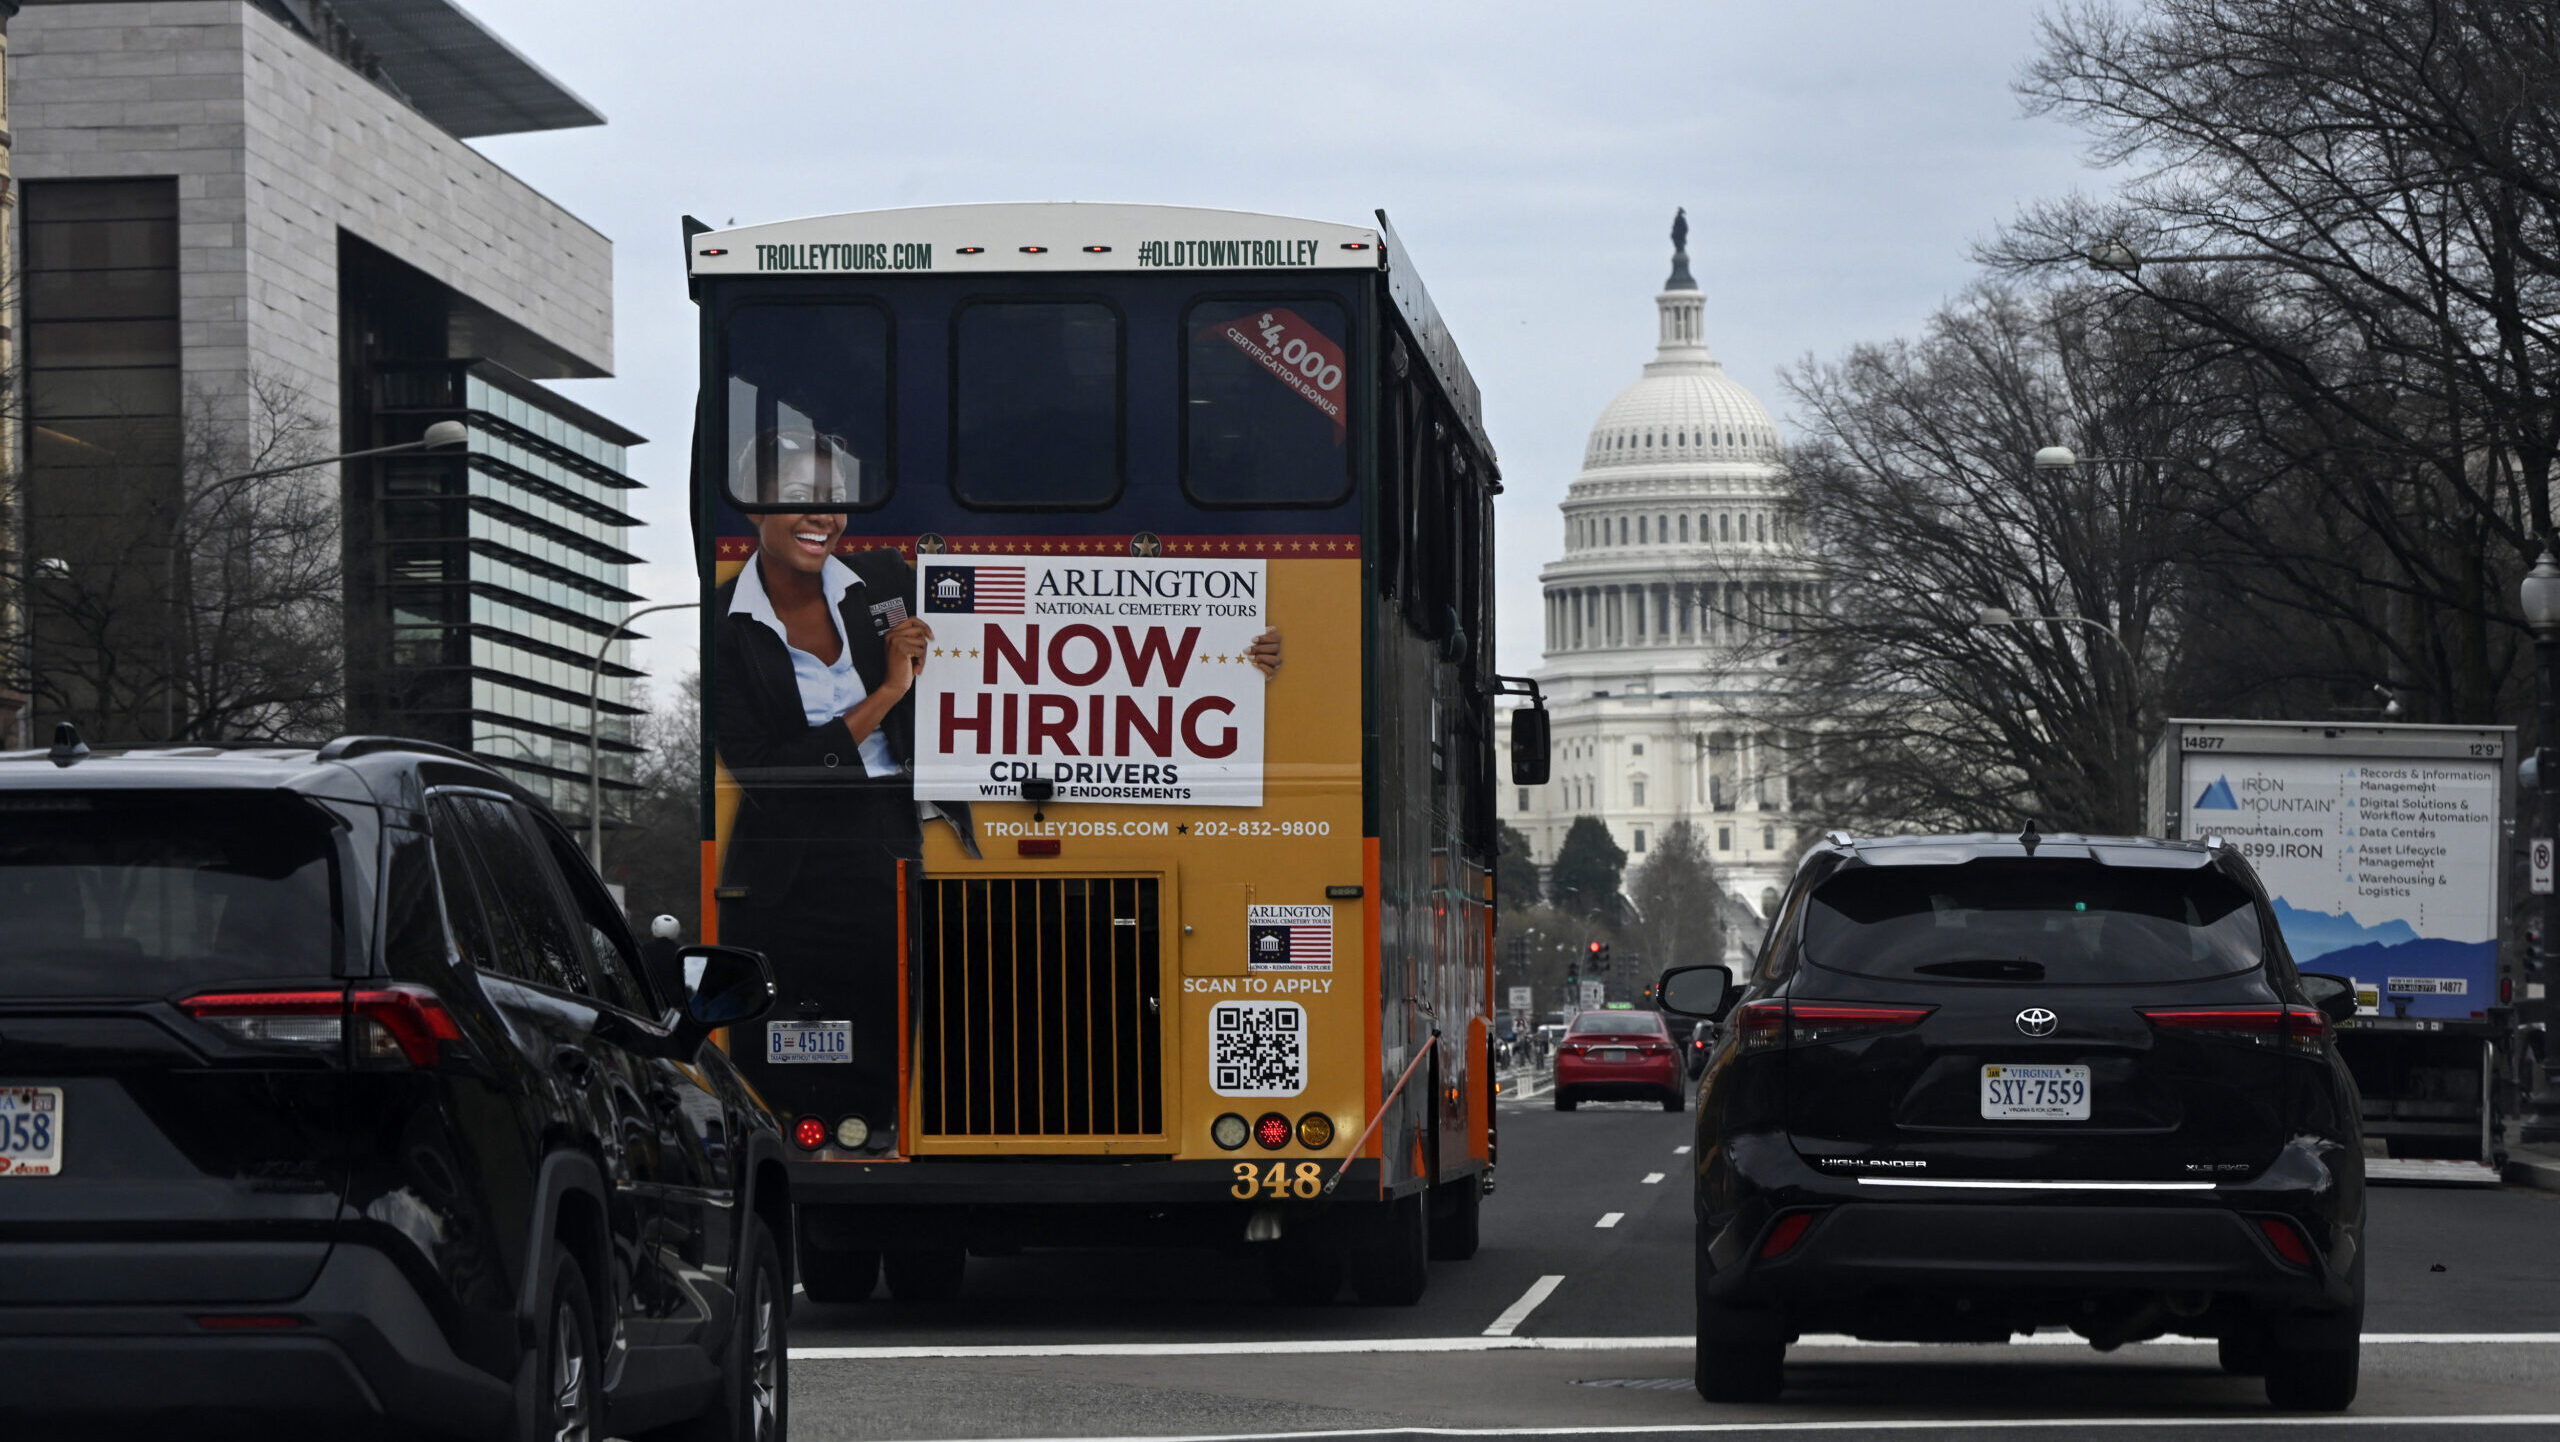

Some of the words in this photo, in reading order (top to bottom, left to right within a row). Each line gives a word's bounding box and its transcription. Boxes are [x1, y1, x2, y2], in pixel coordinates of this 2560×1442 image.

[756, 243, 932, 271] TROLLEYTOURS.COM
[1138, 240, 1318, 267] #OLDTOWNTROLLEY
[1258, 313, 1342, 391] $4,000
[1227, 327, 1301, 388] CERTIFICATION
[1301, 384, 1338, 416] BONUS
[1035, 569, 1258, 598] ARLINGTON
[1036, 602, 1114, 615] NATIONAL
[1119, 603, 1202, 616] CEMETERY
[1206, 604, 1257, 617] TOURS
[983, 623, 1201, 688] NOW
[939, 692, 1238, 759] HIRING
[2183, 736, 2224, 749] 14877
[990, 761, 1039, 782] CDL
[1054, 763, 1178, 785] DRIVERS
[2361, 768, 2407, 779] Records
[2411, 769, 2419, 779] &
[2423, 769, 2491, 780] Information
[980, 785, 1017, 796] WITH
[1070, 787, 1191, 799] ENDORSEMENTS
[2242, 778, 2284, 792] IRON
[2361, 781, 2436, 793] Management
[2360, 797, 2399, 809] Digital
[2402, 798, 2457, 809] Solutions
[2460, 800, 2469, 810] &
[2360, 811, 2415, 821] Workflow
[2420, 812, 2489, 823] Automation
[984, 821, 1169, 836] TROLLEYJOBS.COM
[1194, 821, 1330, 836] 202-832-9800
[2196, 824, 2323, 837] ironmountain.com
[2360, 827, 2388, 837] Data
[2392, 828, 2436, 838] Centers
[2360, 844, 2391, 855] Asset
[2396, 845, 2446, 857] Lifecycle
[2359, 857, 2434, 869] Management
[2359, 873, 2434, 886] Warehousing
[2438, 875, 2447, 885] &
[2358, 886, 2411, 897] Logistics
[1250, 907, 1331, 917] ARLINGTON
[1183, 978, 1237, 993] SCAN
[1242, 978, 1268, 993] TO
[1272, 978, 1333, 993] APPLY
[2440, 982, 2462, 993] 14877
[773, 1032, 781, 1053] B
[799, 1032, 845, 1053] 45116
[2011, 1068, 2062, 1079] VIRGINIA
[1990, 1079, 2084, 1105] SXY-7559
[1821, 1158, 1927, 1168] HIGHLANDER
[1231, 1162, 1321, 1200] 348
